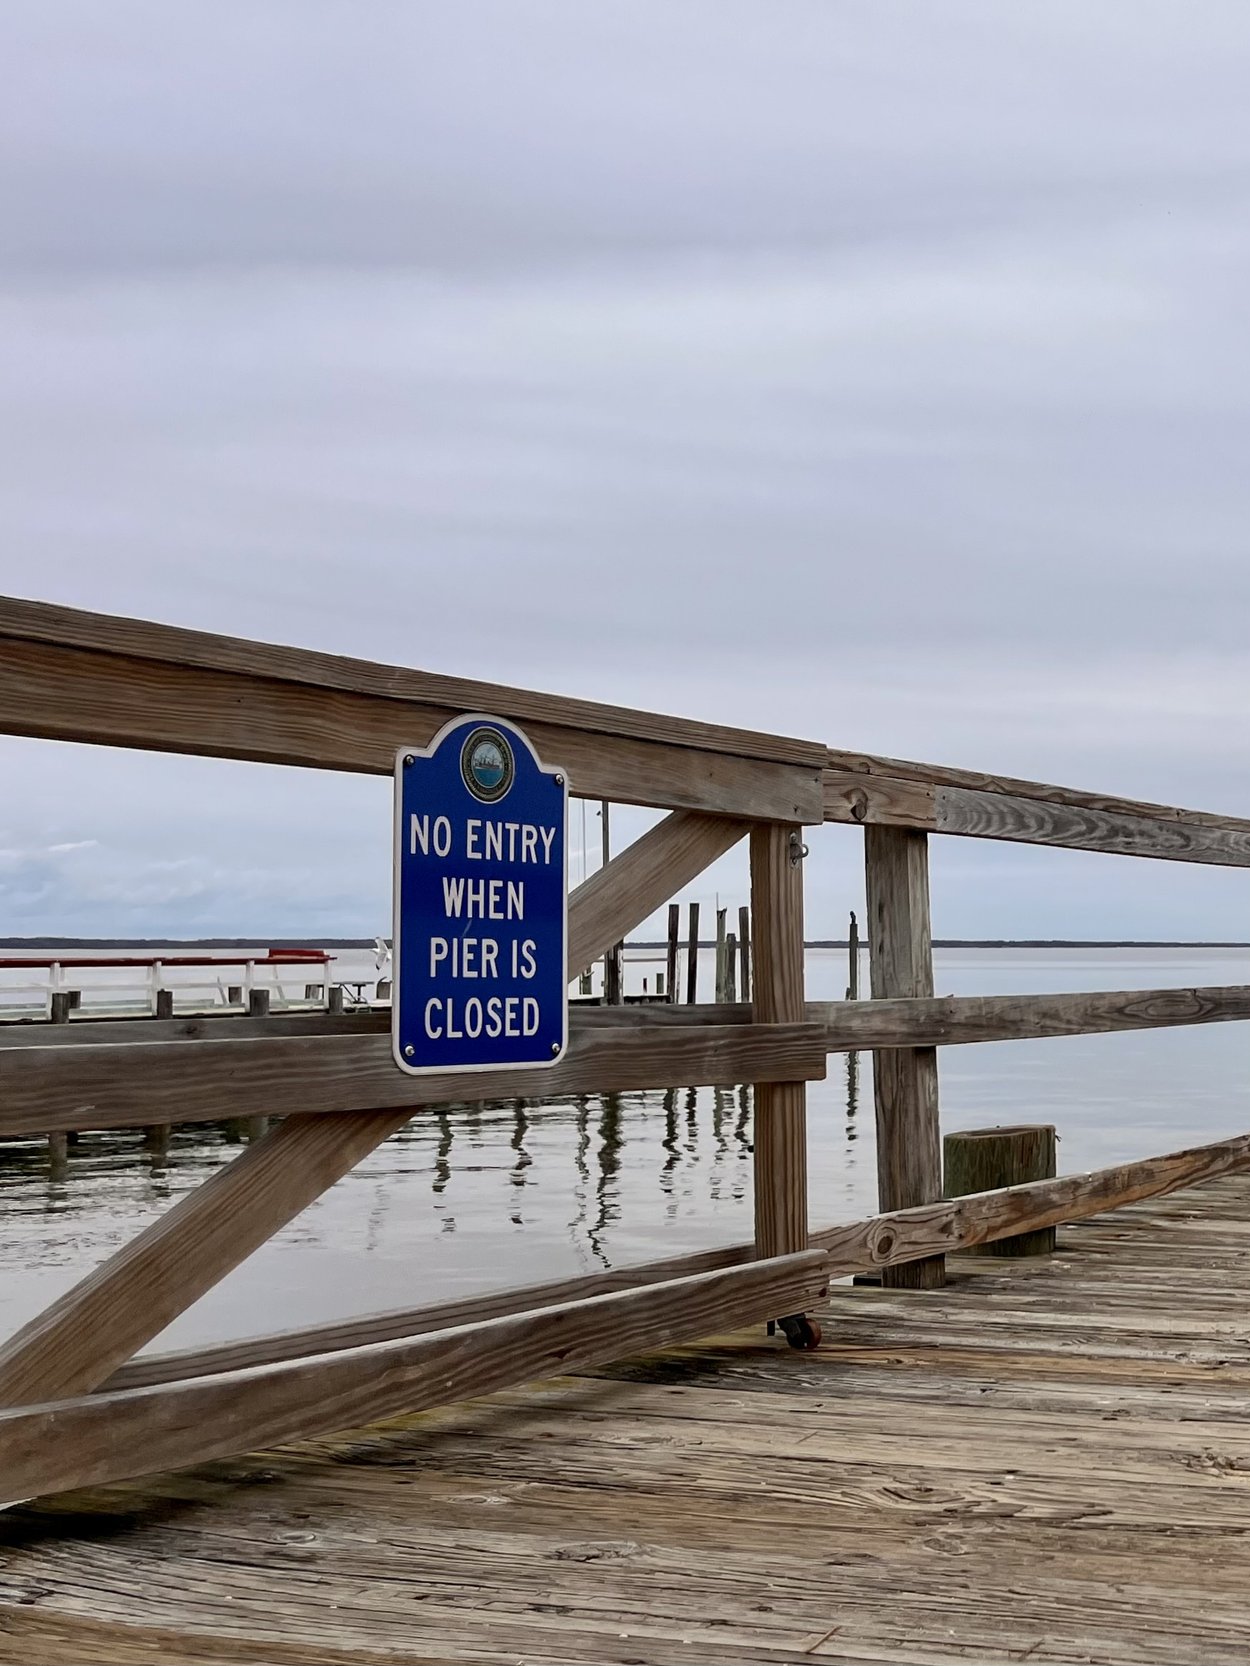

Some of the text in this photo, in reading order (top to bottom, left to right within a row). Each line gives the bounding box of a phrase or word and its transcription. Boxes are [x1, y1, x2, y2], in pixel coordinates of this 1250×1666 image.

[410, 813, 556, 865] NO ENTRY
[442, 876, 524, 920] WHEN
[430, 937, 537, 979] PIER IS
[424, 997, 540, 1039] CLOSED
